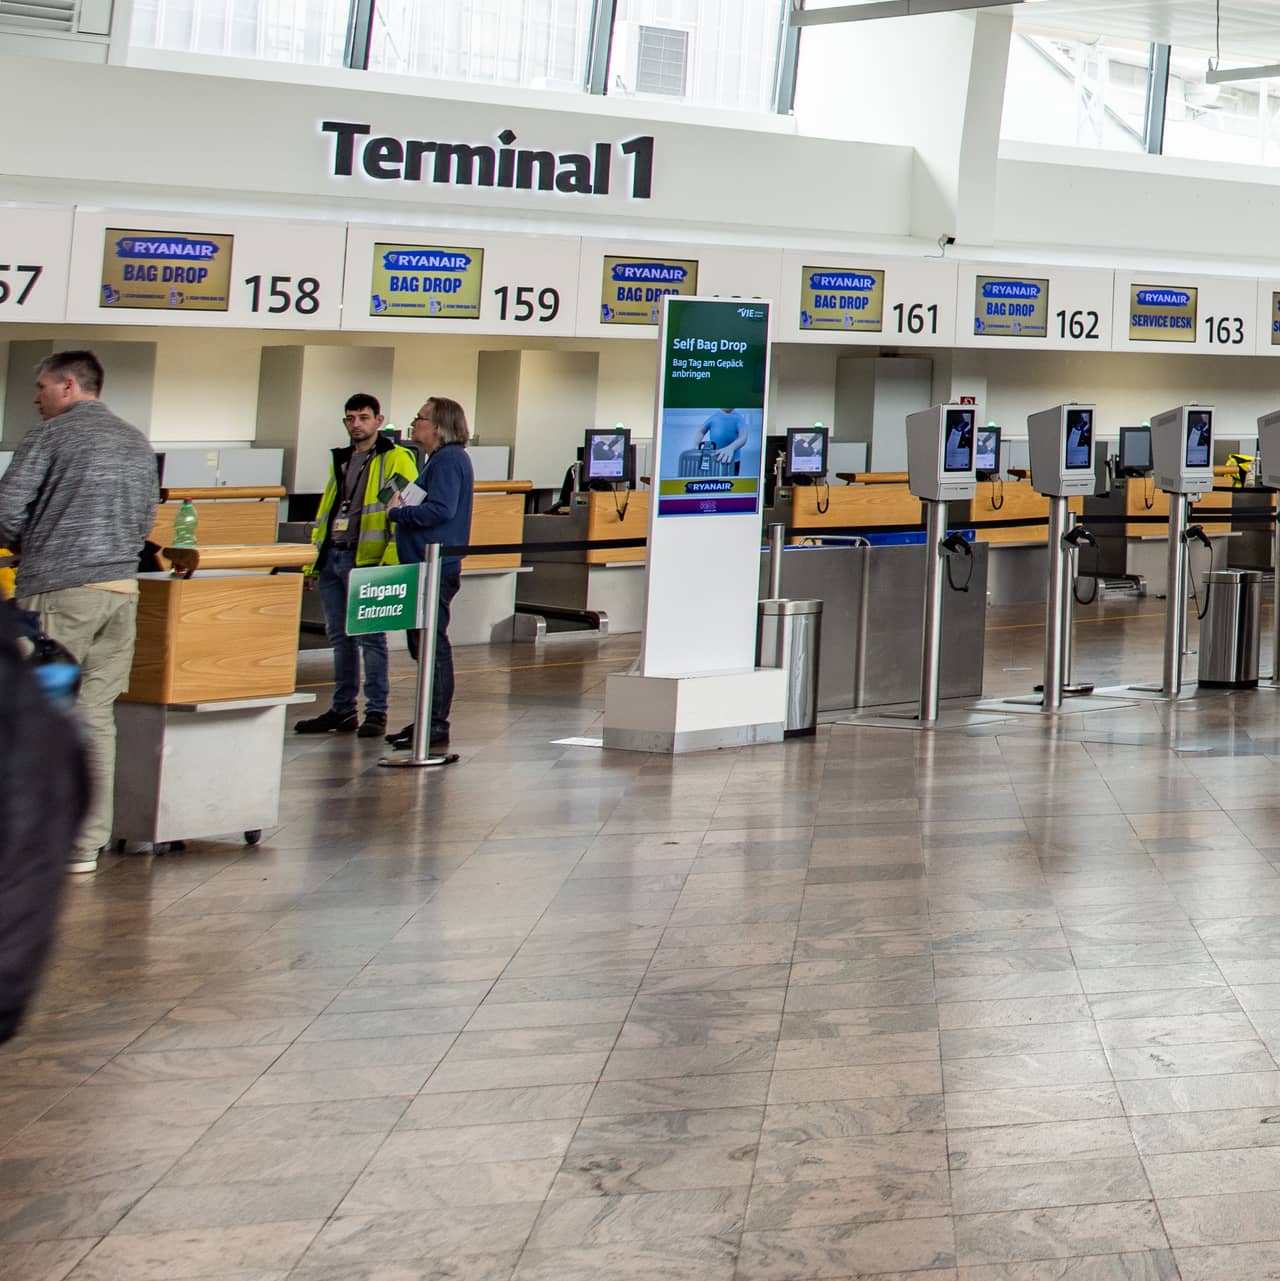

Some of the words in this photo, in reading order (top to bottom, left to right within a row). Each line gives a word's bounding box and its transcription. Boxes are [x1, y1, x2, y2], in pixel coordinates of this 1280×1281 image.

[322, 120, 612, 195] Terminal
[621, 136, 654, 199] 1
[134, 241, 213, 257] RYANAIR
[398, 255, 466, 268] RYANAIR
[123, 264, 158, 282] BAG
[162, 266, 208, 284] DROP
[624, 267, 684, 279] RYANAIR
[389, 275, 419, 293] BAG
[422, 277, 462, 293] DROP
[821, 276, 872, 288] RYANAIR
[244, 275, 321, 314] 158
[617, 287, 642, 301] BAG
[992, 285, 1038, 297] RYANAIR
[1145, 293, 1187, 304] RYANAIR
[493, 286, 560, 322] 159
[814, 295, 836, 309] BAG
[839, 296, 869, 310] DROP
[986, 302, 1007, 315] BAG
[1008, 303, 1035, 317] DROP
[893, 303, 938, 334] 161
[1056, 310, 1099, 339] 162
[1132, 314, 1168, 328] SERVICE
[1169, 316, 1192, 329] DESK
[1204, 316, 1244, 344] 163
[673, 338, 694, 352] Self
[697, 339, 718, 353] Bag
[720, 340, 747, 353] Drop
[672, 359, 687, 368] Bag
[688, 359, 702, 368] Tag
[717, 359, 744, 369] Gepäck
[672, 370, 711, 379] anbringen
[693, 482, 731, 491] RYANAIR
[359, 582, 407, 600] Eingang
[357, 604, 404, 620] Entrance
